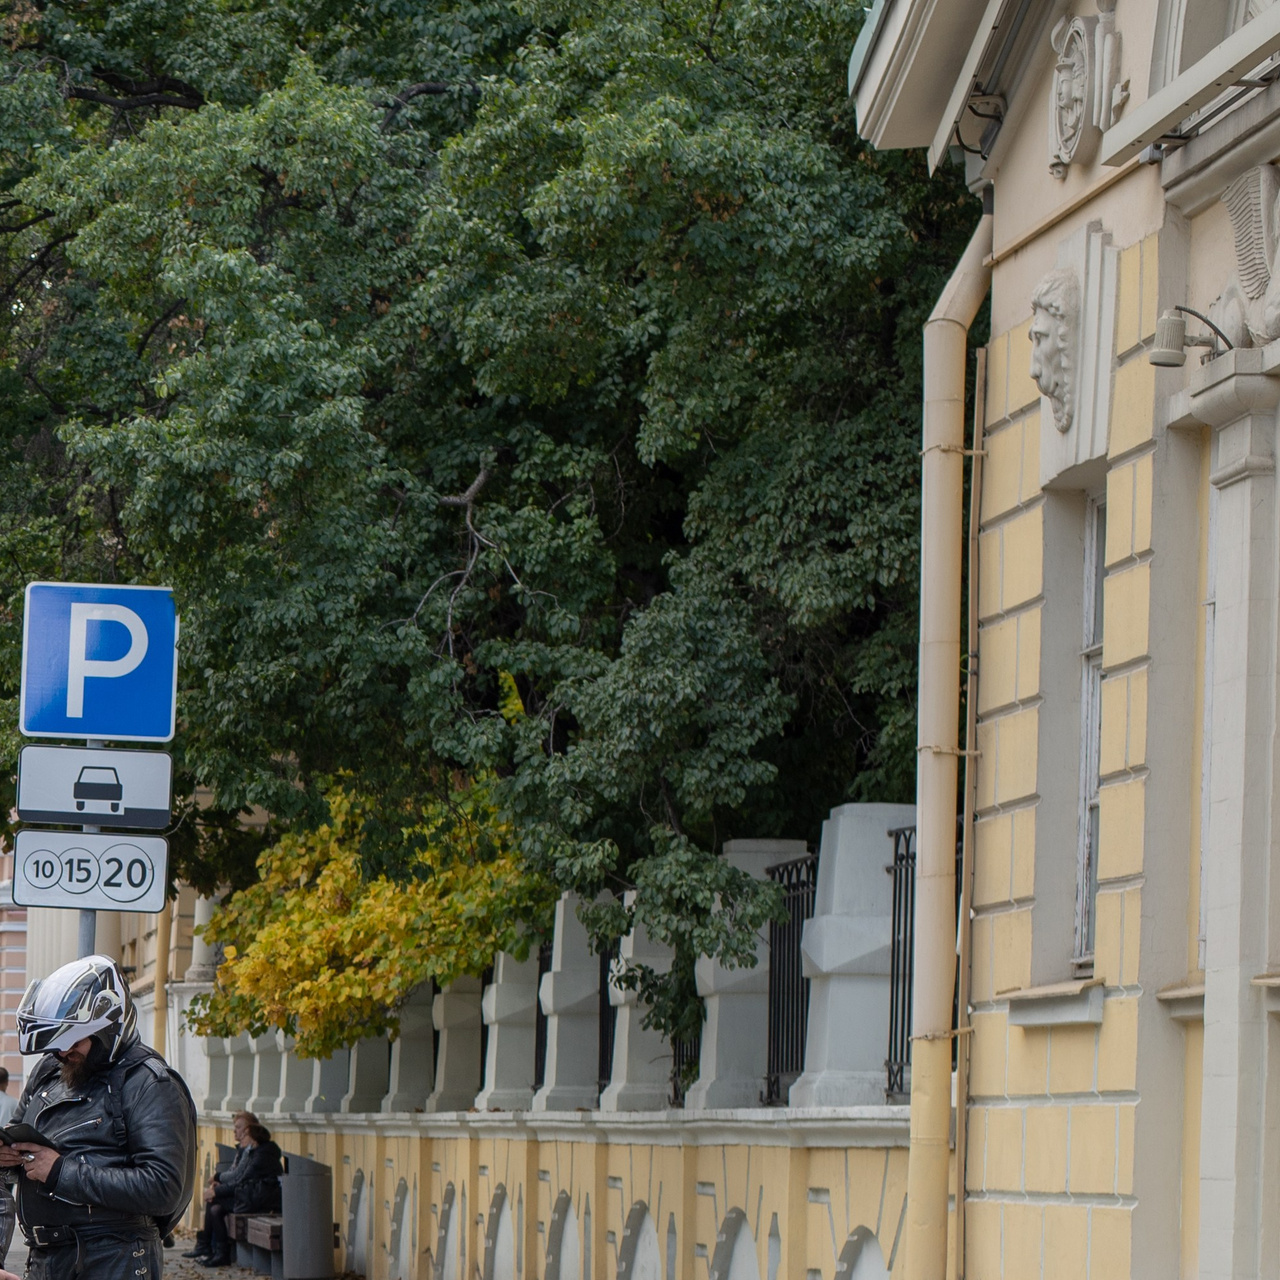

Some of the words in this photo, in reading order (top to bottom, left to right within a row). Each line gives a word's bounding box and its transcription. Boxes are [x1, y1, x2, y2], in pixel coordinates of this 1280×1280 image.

[66, 602, 149, 718] P
[32, 859, 54, 878] 10
[65, 858, 91, 883] 15
[103, 857, 147, 888] 20
